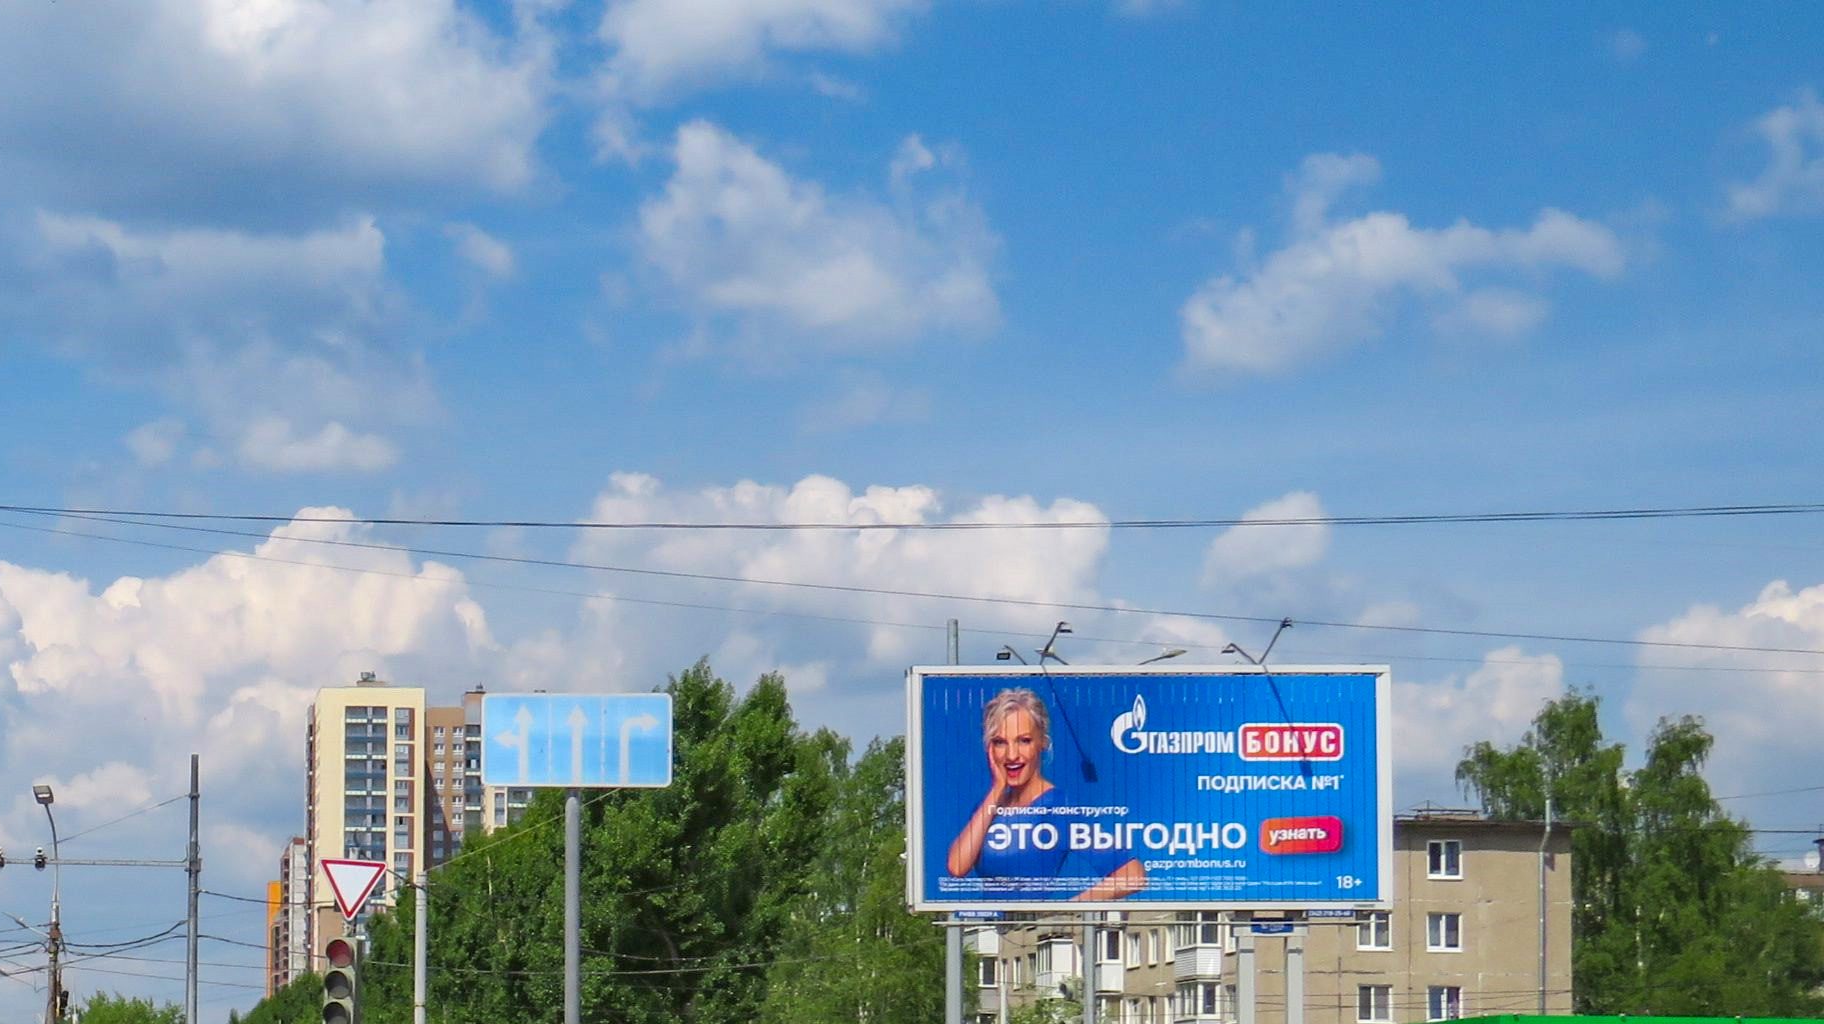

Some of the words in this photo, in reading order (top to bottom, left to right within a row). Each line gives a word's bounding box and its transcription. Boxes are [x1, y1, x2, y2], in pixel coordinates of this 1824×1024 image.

[1148, 730, 1234, 755] ГАЗПРОМ
[1245, 730, 1336, 755] БОНУС
[1197, 775, 1307, 794] ПОДПИСКА
[987, 804, 1129, 818] Подписка-конструктор
[987, 822, 1059, 851] ЭТО
[1070, 821, 1247, 855] ВЫГОДНО
[1269, 827, 1327, 845] узнать
[1143, 858, 1246, 872] gazprombonus.ru
[1336, 875, 1363, 889] 18+
